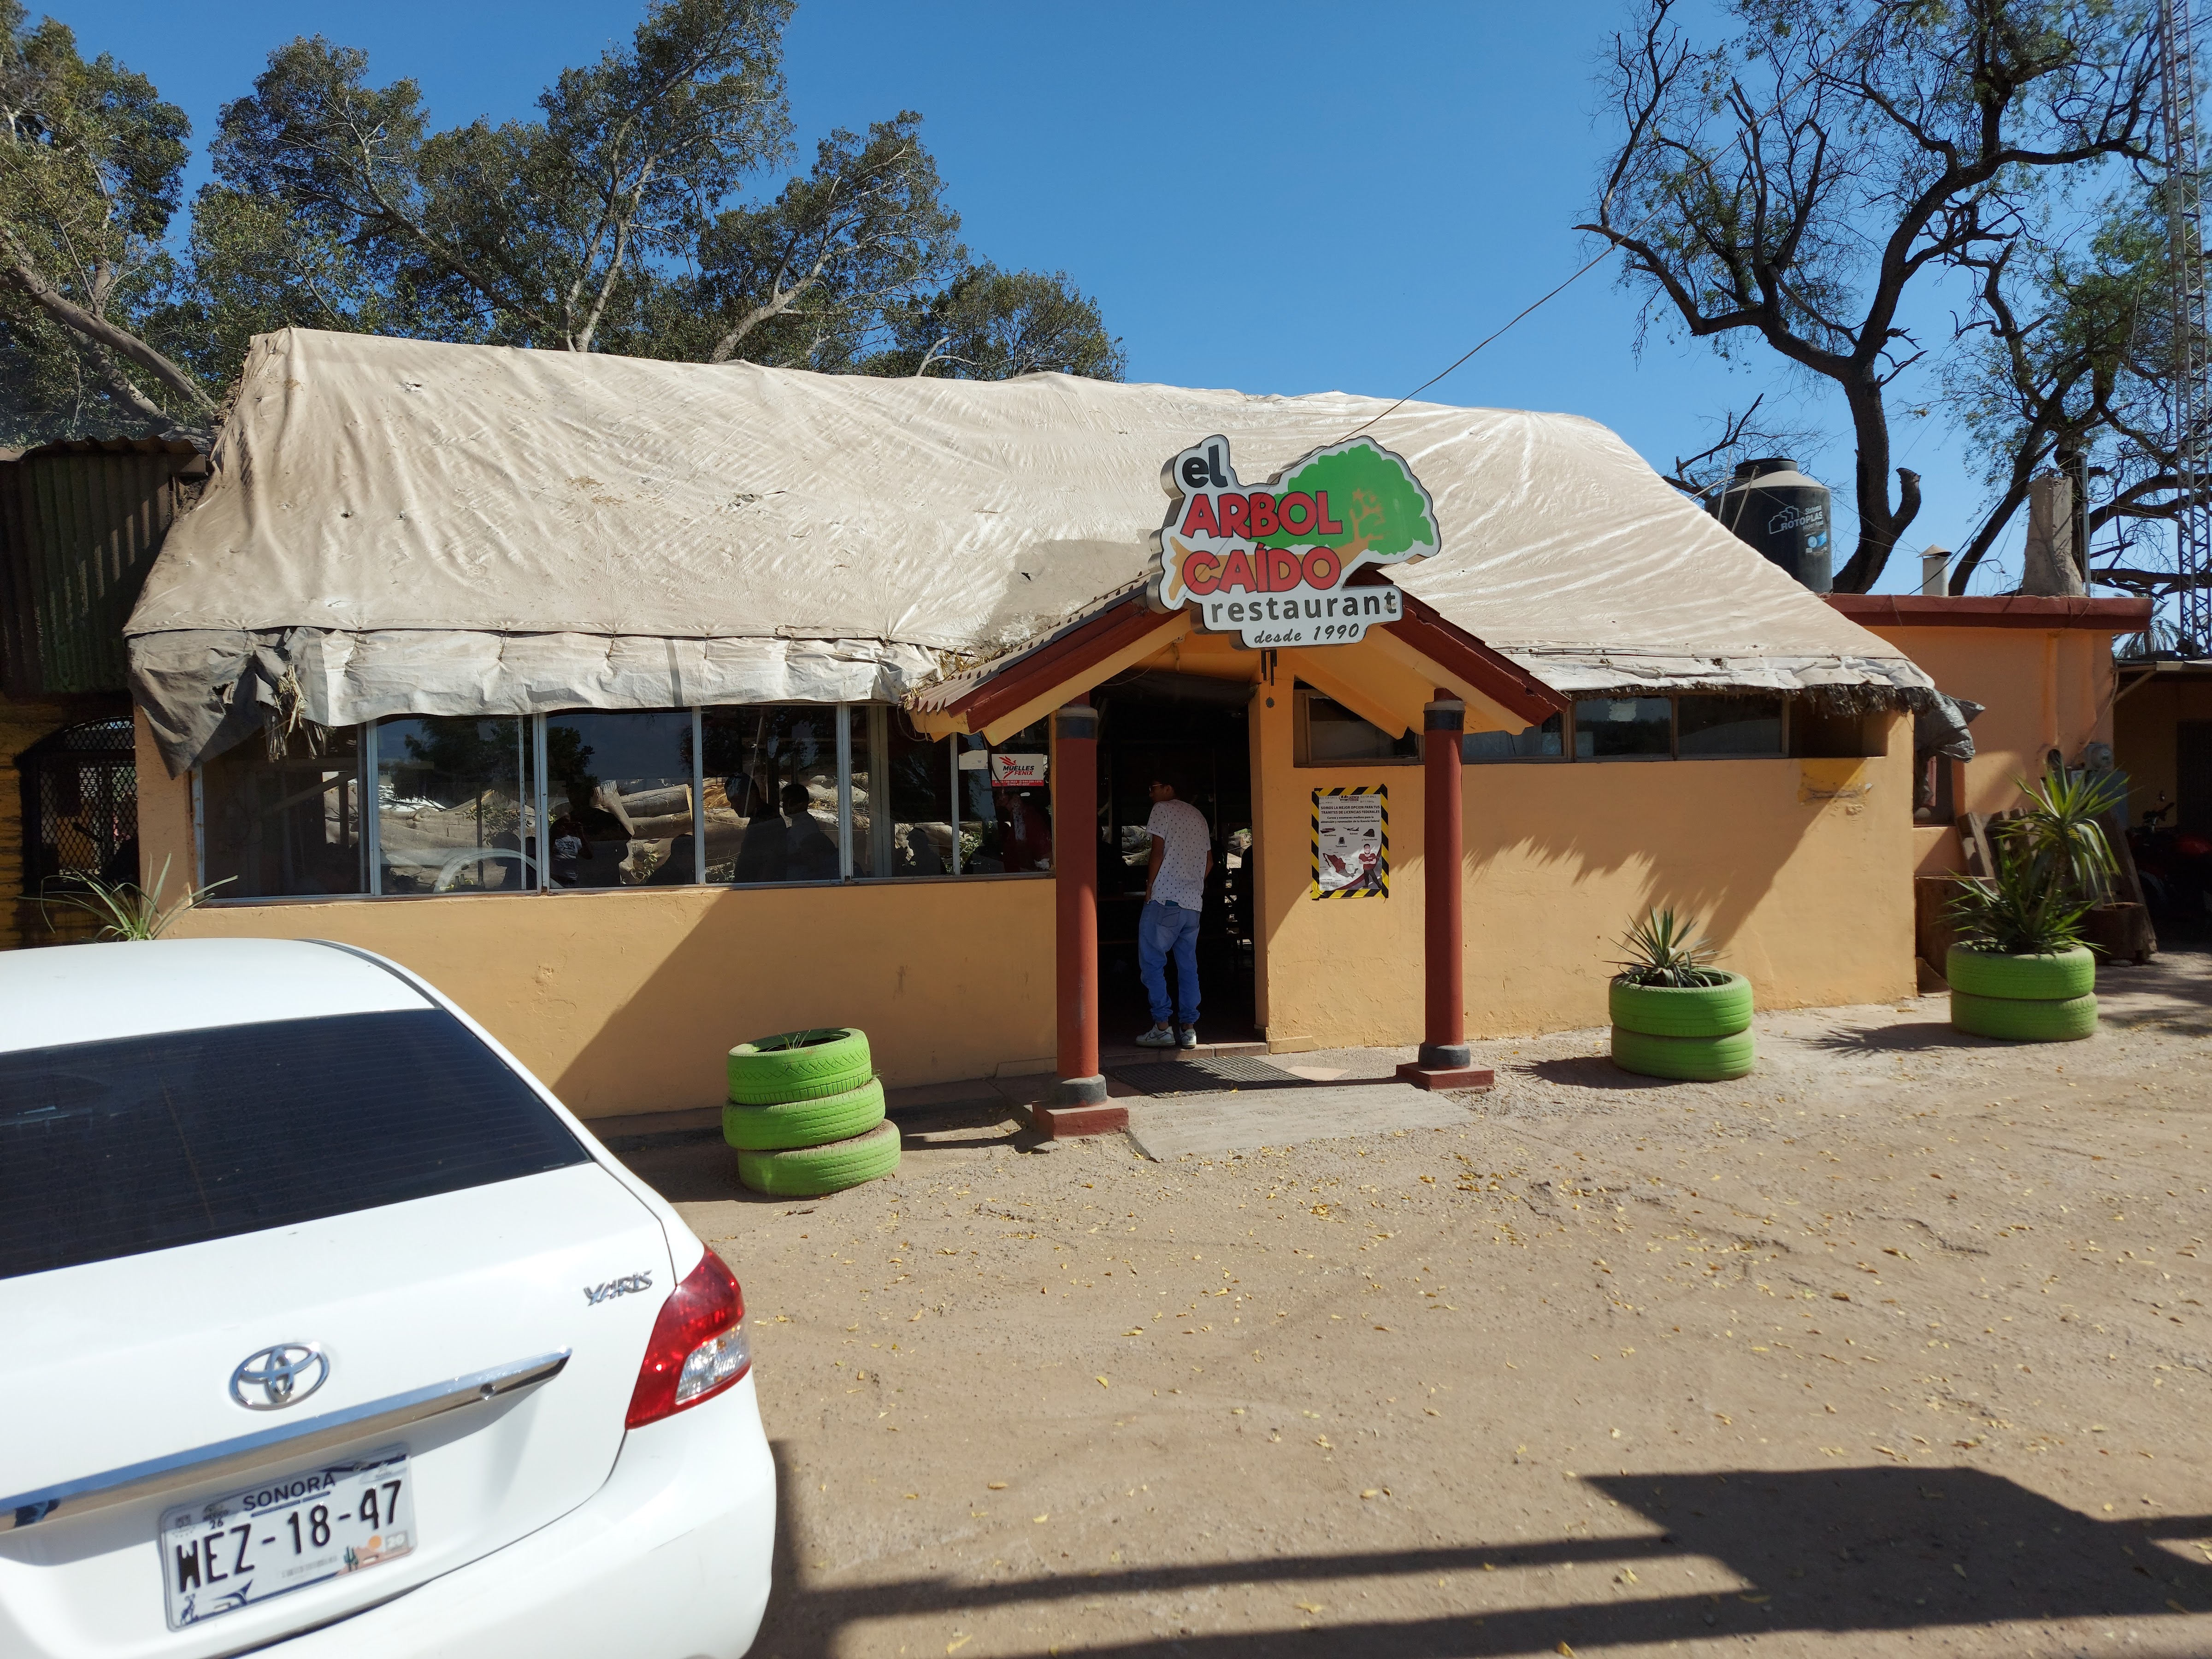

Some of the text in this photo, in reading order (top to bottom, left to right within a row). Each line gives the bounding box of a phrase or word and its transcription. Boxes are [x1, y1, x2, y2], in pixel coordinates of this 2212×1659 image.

[1182, 444, 1228, 488] el
[1180, 490, 1343, 539] ARBOL
[1781, 511, 1823, 531] ROTOPLAS
[1182, 543, 1342, 596] CAÍDO
[1211, 591, 1397, 623] restaurant
[1254, 624, 1359, 644] desde 1990
[242, 1471, 337, 1511] SONORA
[209, 1518, 224, 1529] 26
